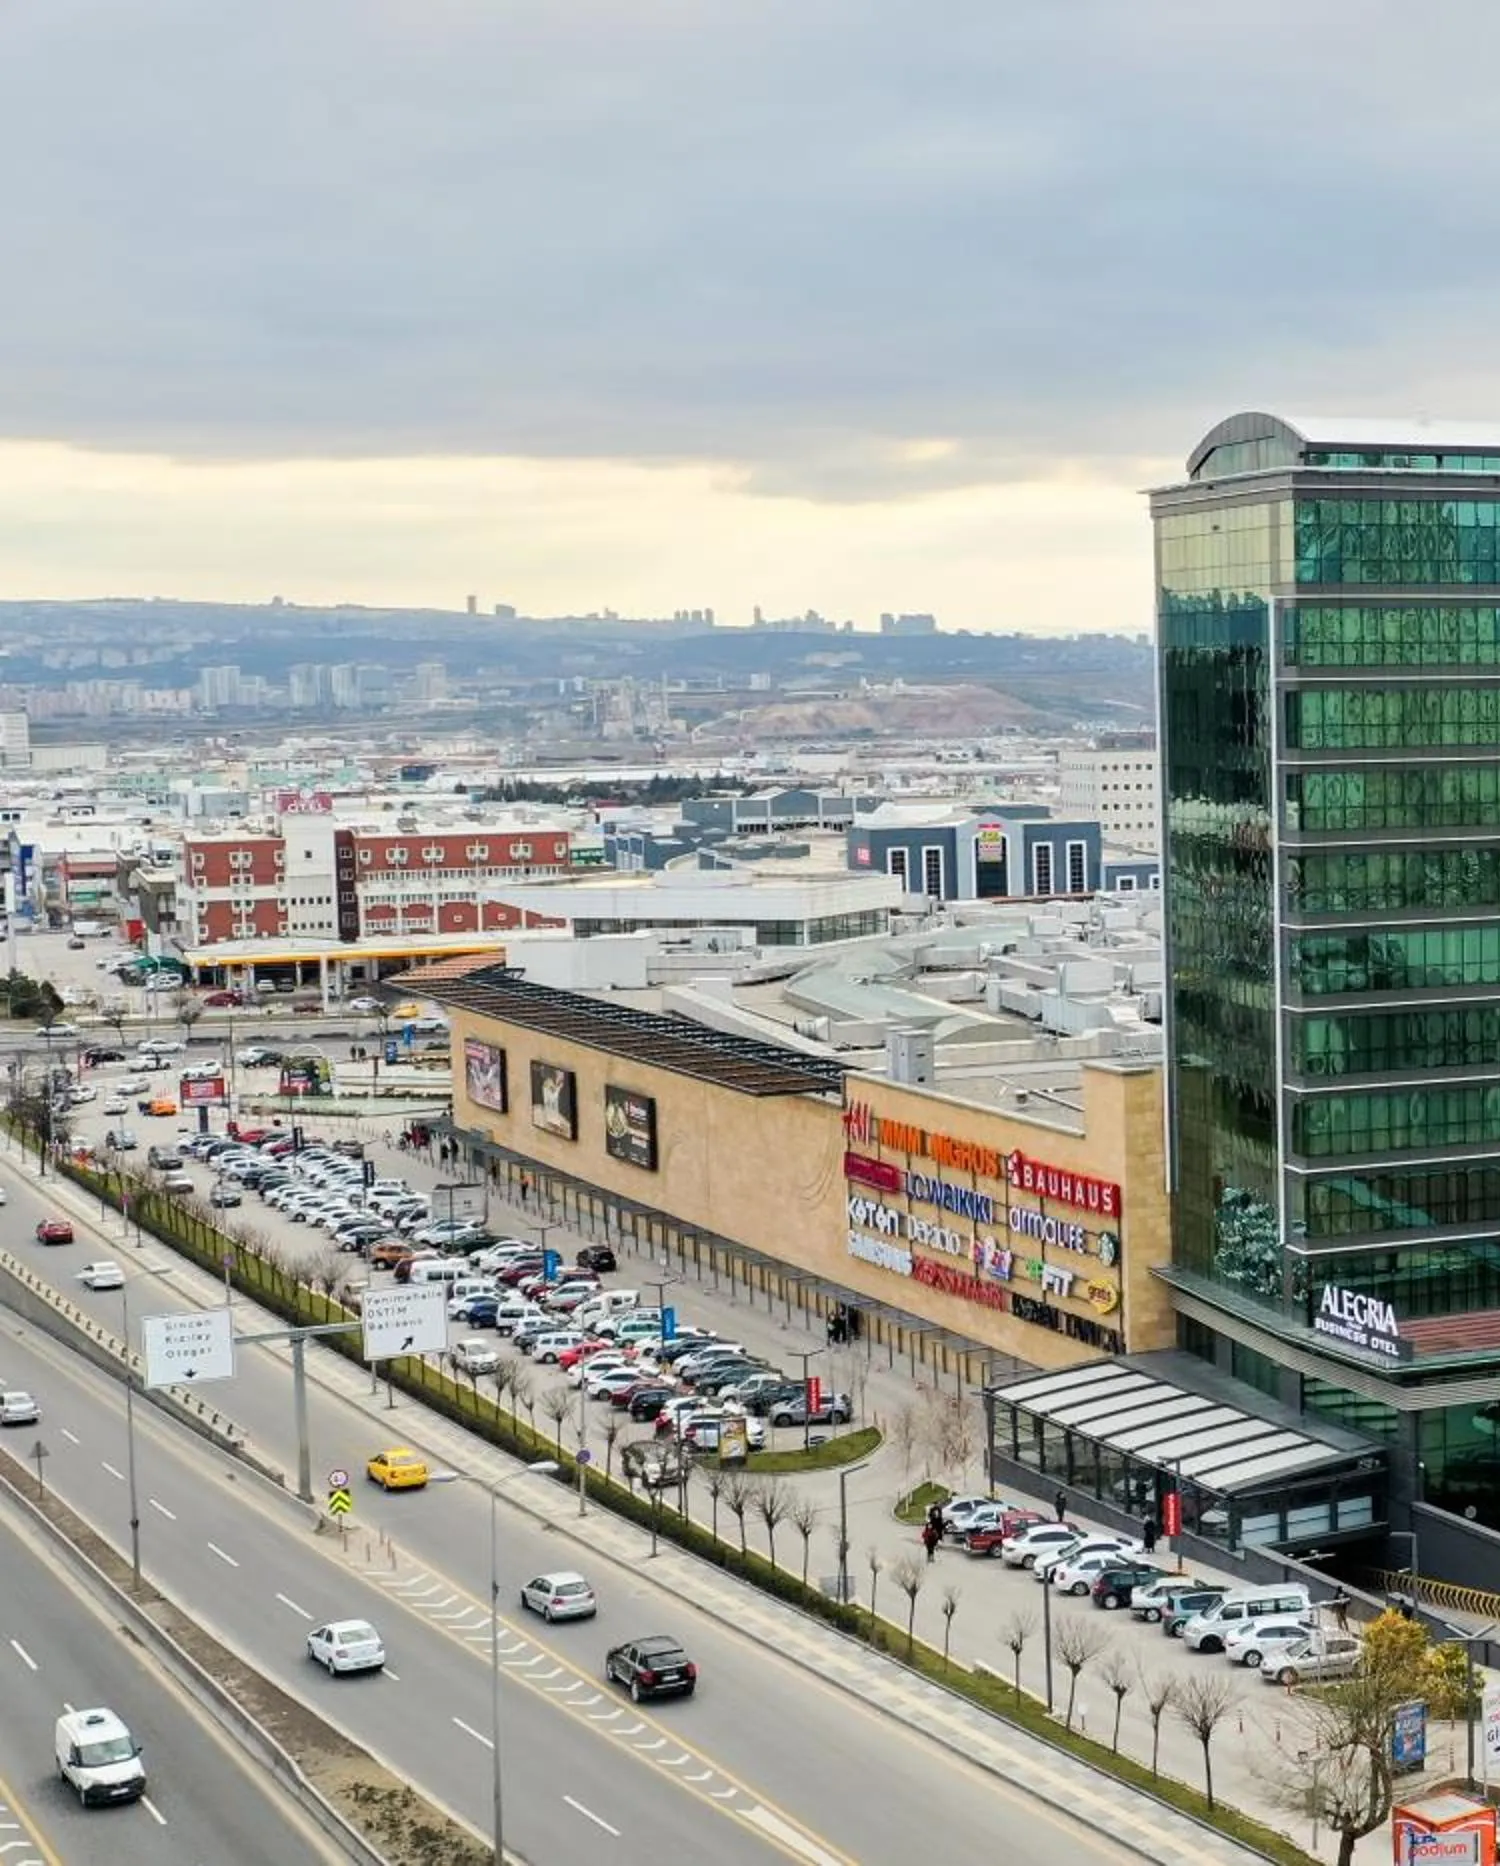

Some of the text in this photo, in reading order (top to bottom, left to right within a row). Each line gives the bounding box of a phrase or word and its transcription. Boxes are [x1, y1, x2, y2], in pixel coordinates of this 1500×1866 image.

[1023, 1165, 1113, 1212] BAUHAUS
[1321, 1283, 1398, 1336] ALEGRIA
[1371, 1337, 1400, 1356] OTEL
[1408, 1842, 1468, 1860] podium
